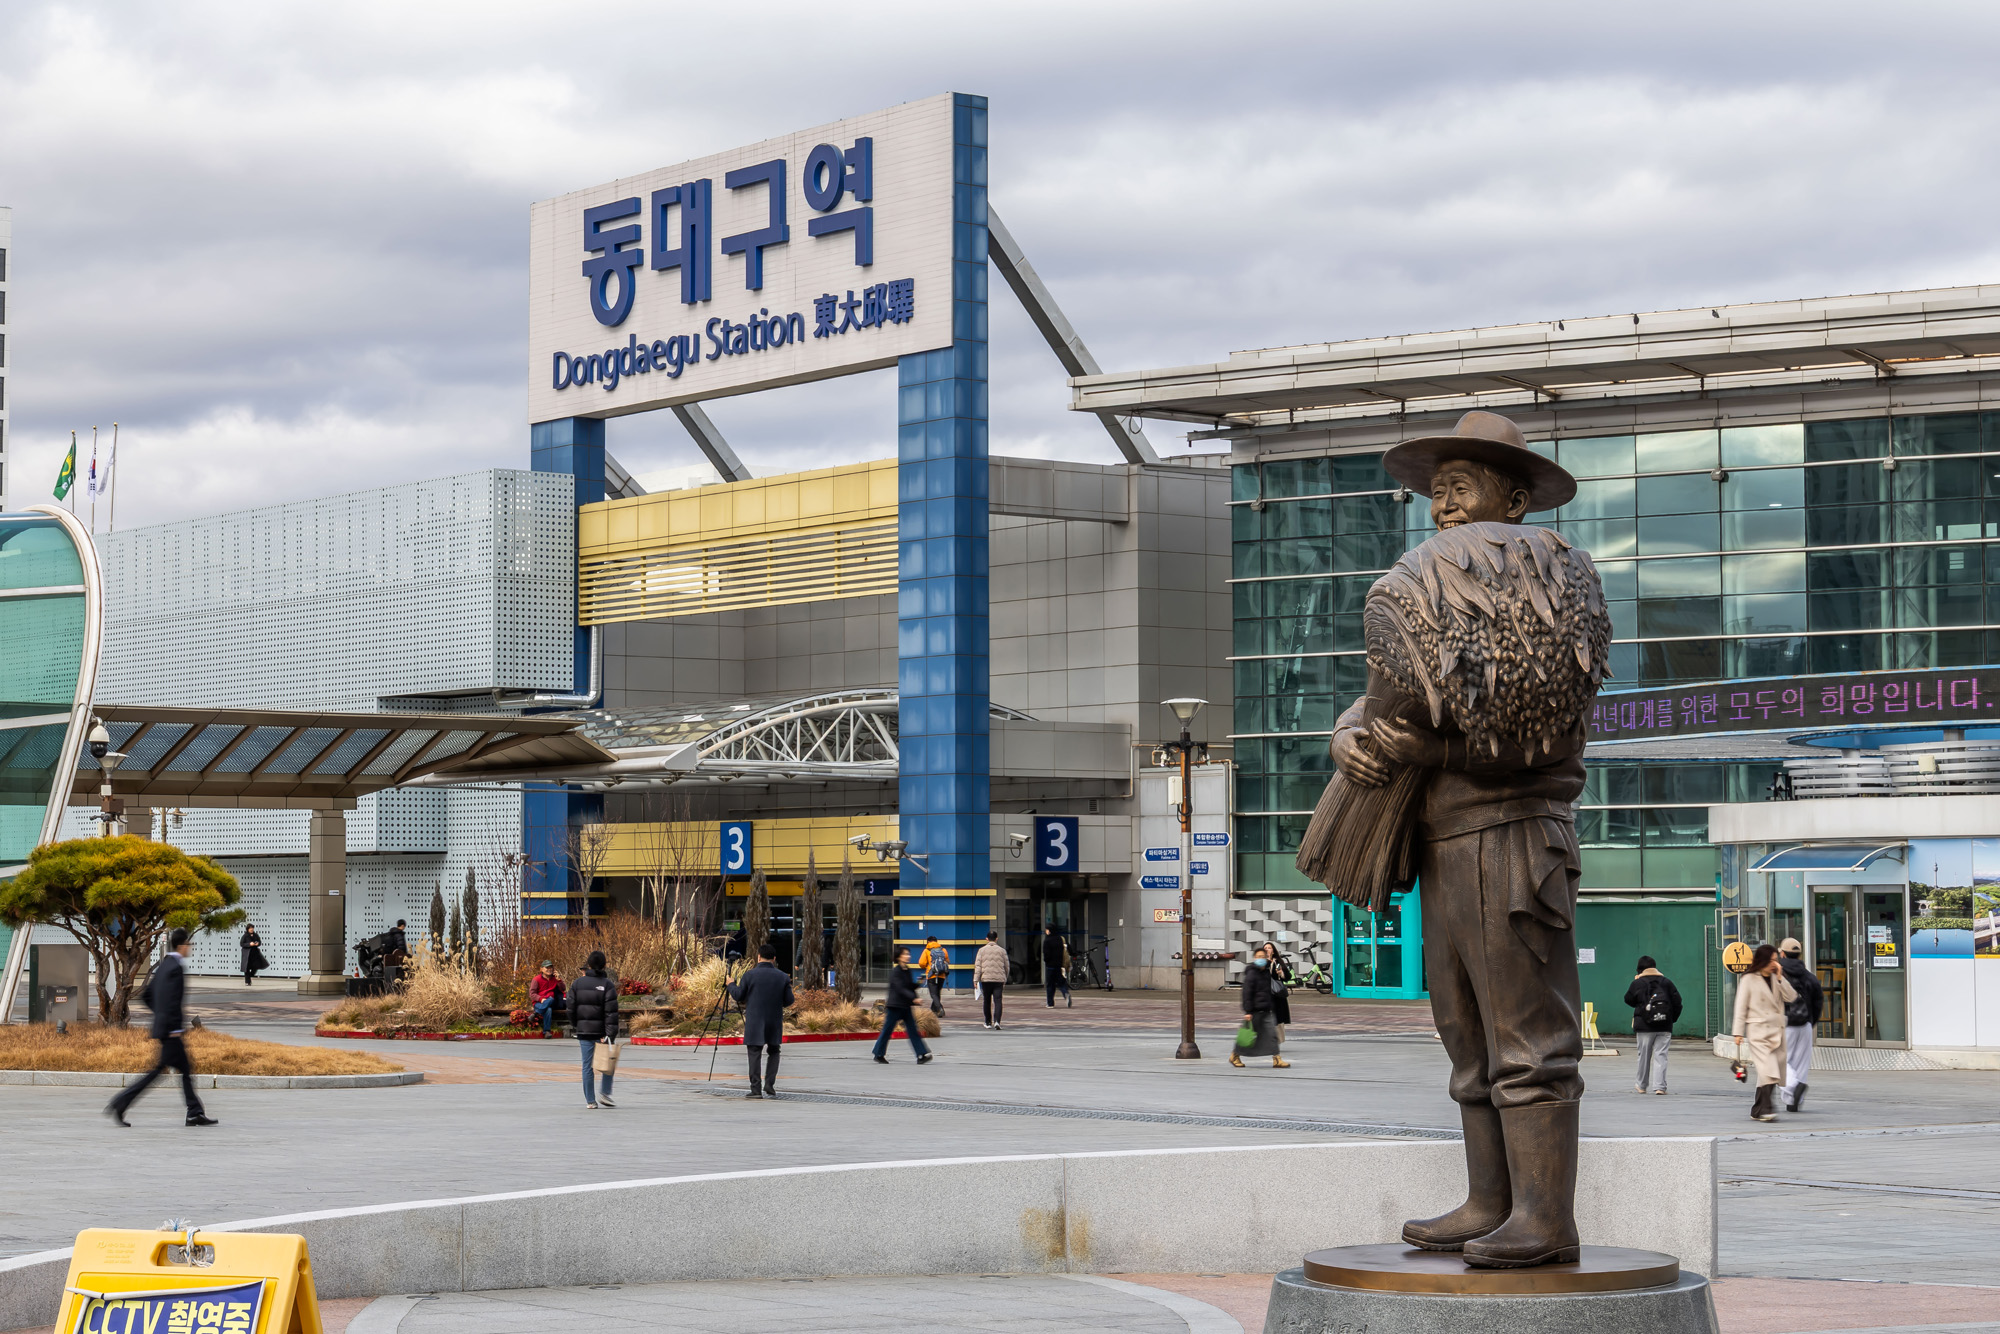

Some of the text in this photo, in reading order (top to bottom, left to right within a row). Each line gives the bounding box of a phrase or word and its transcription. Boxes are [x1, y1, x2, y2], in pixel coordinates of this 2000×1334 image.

[582, 137, 873, 327] 동대구역
[813, 278, 914, 338] 東大邱驛
[553, 308, 805, 392] Dongdaegu Station
[1681, 694, 1719, 726] 위한
[1729, 687, 1804, 720] 모두의
[1819, 678, 1993, 716] 희망입니다.
[728, 826, 745, 870] 3
[1046, 822, 1069, 867] 3
[730, 883, 735, 894] 3
[869, 881, 875, 894] 3
[83, 1299, 251, 1334] CCTV 촬영중
